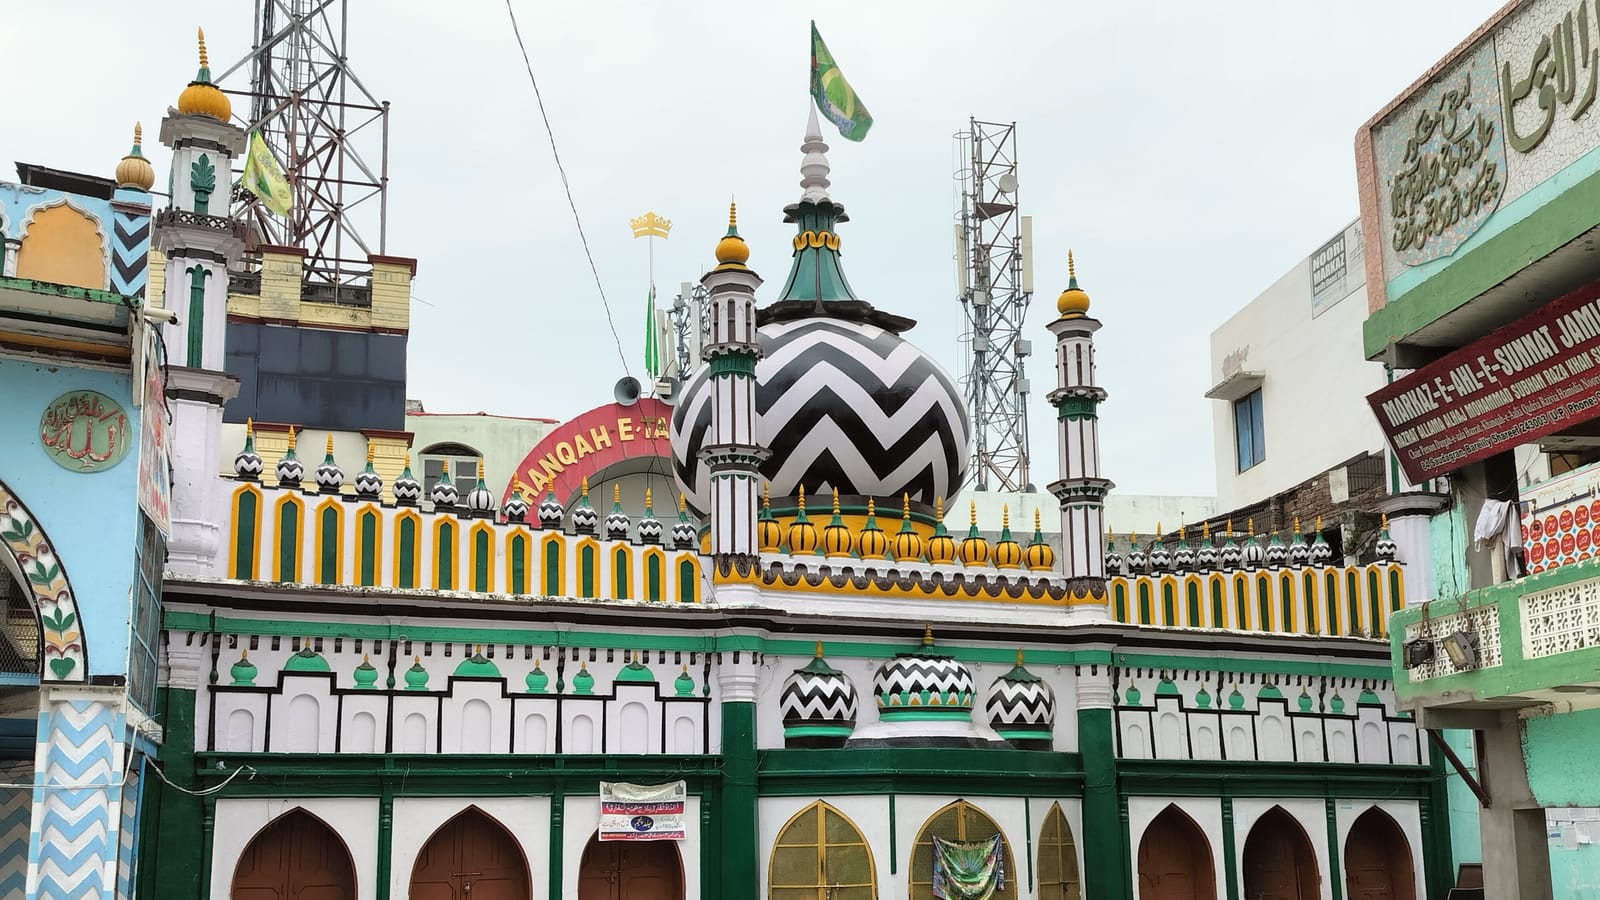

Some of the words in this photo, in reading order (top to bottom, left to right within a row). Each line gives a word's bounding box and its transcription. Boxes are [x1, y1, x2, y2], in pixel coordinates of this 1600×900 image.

[1313, 252, 1345, 287] MARKAZ
[1382, 325, 1560, 427] MARKAZ-E-AHL-E-SUNNAT
[1393, 428, 1420, 449] HAZRAT
[1417, 416, 1446, 439] ALLAMA
[1443, 406, 1468, 428] ALHAJ
[1511, 373, 1547, 399] SUBHAN
[1542, 363, 1570, 386] RAZA
[1565, 351, 1595, 376] KHAN
[1464, 436, 1492, 454] Bareilly
[1490, 427, 1520, 444] Shareef
[1519, 413, 1548, 434] 243003
[1566, 392, 1598, 414] Phone:
[508, 425, 612, 506] HANQAH
